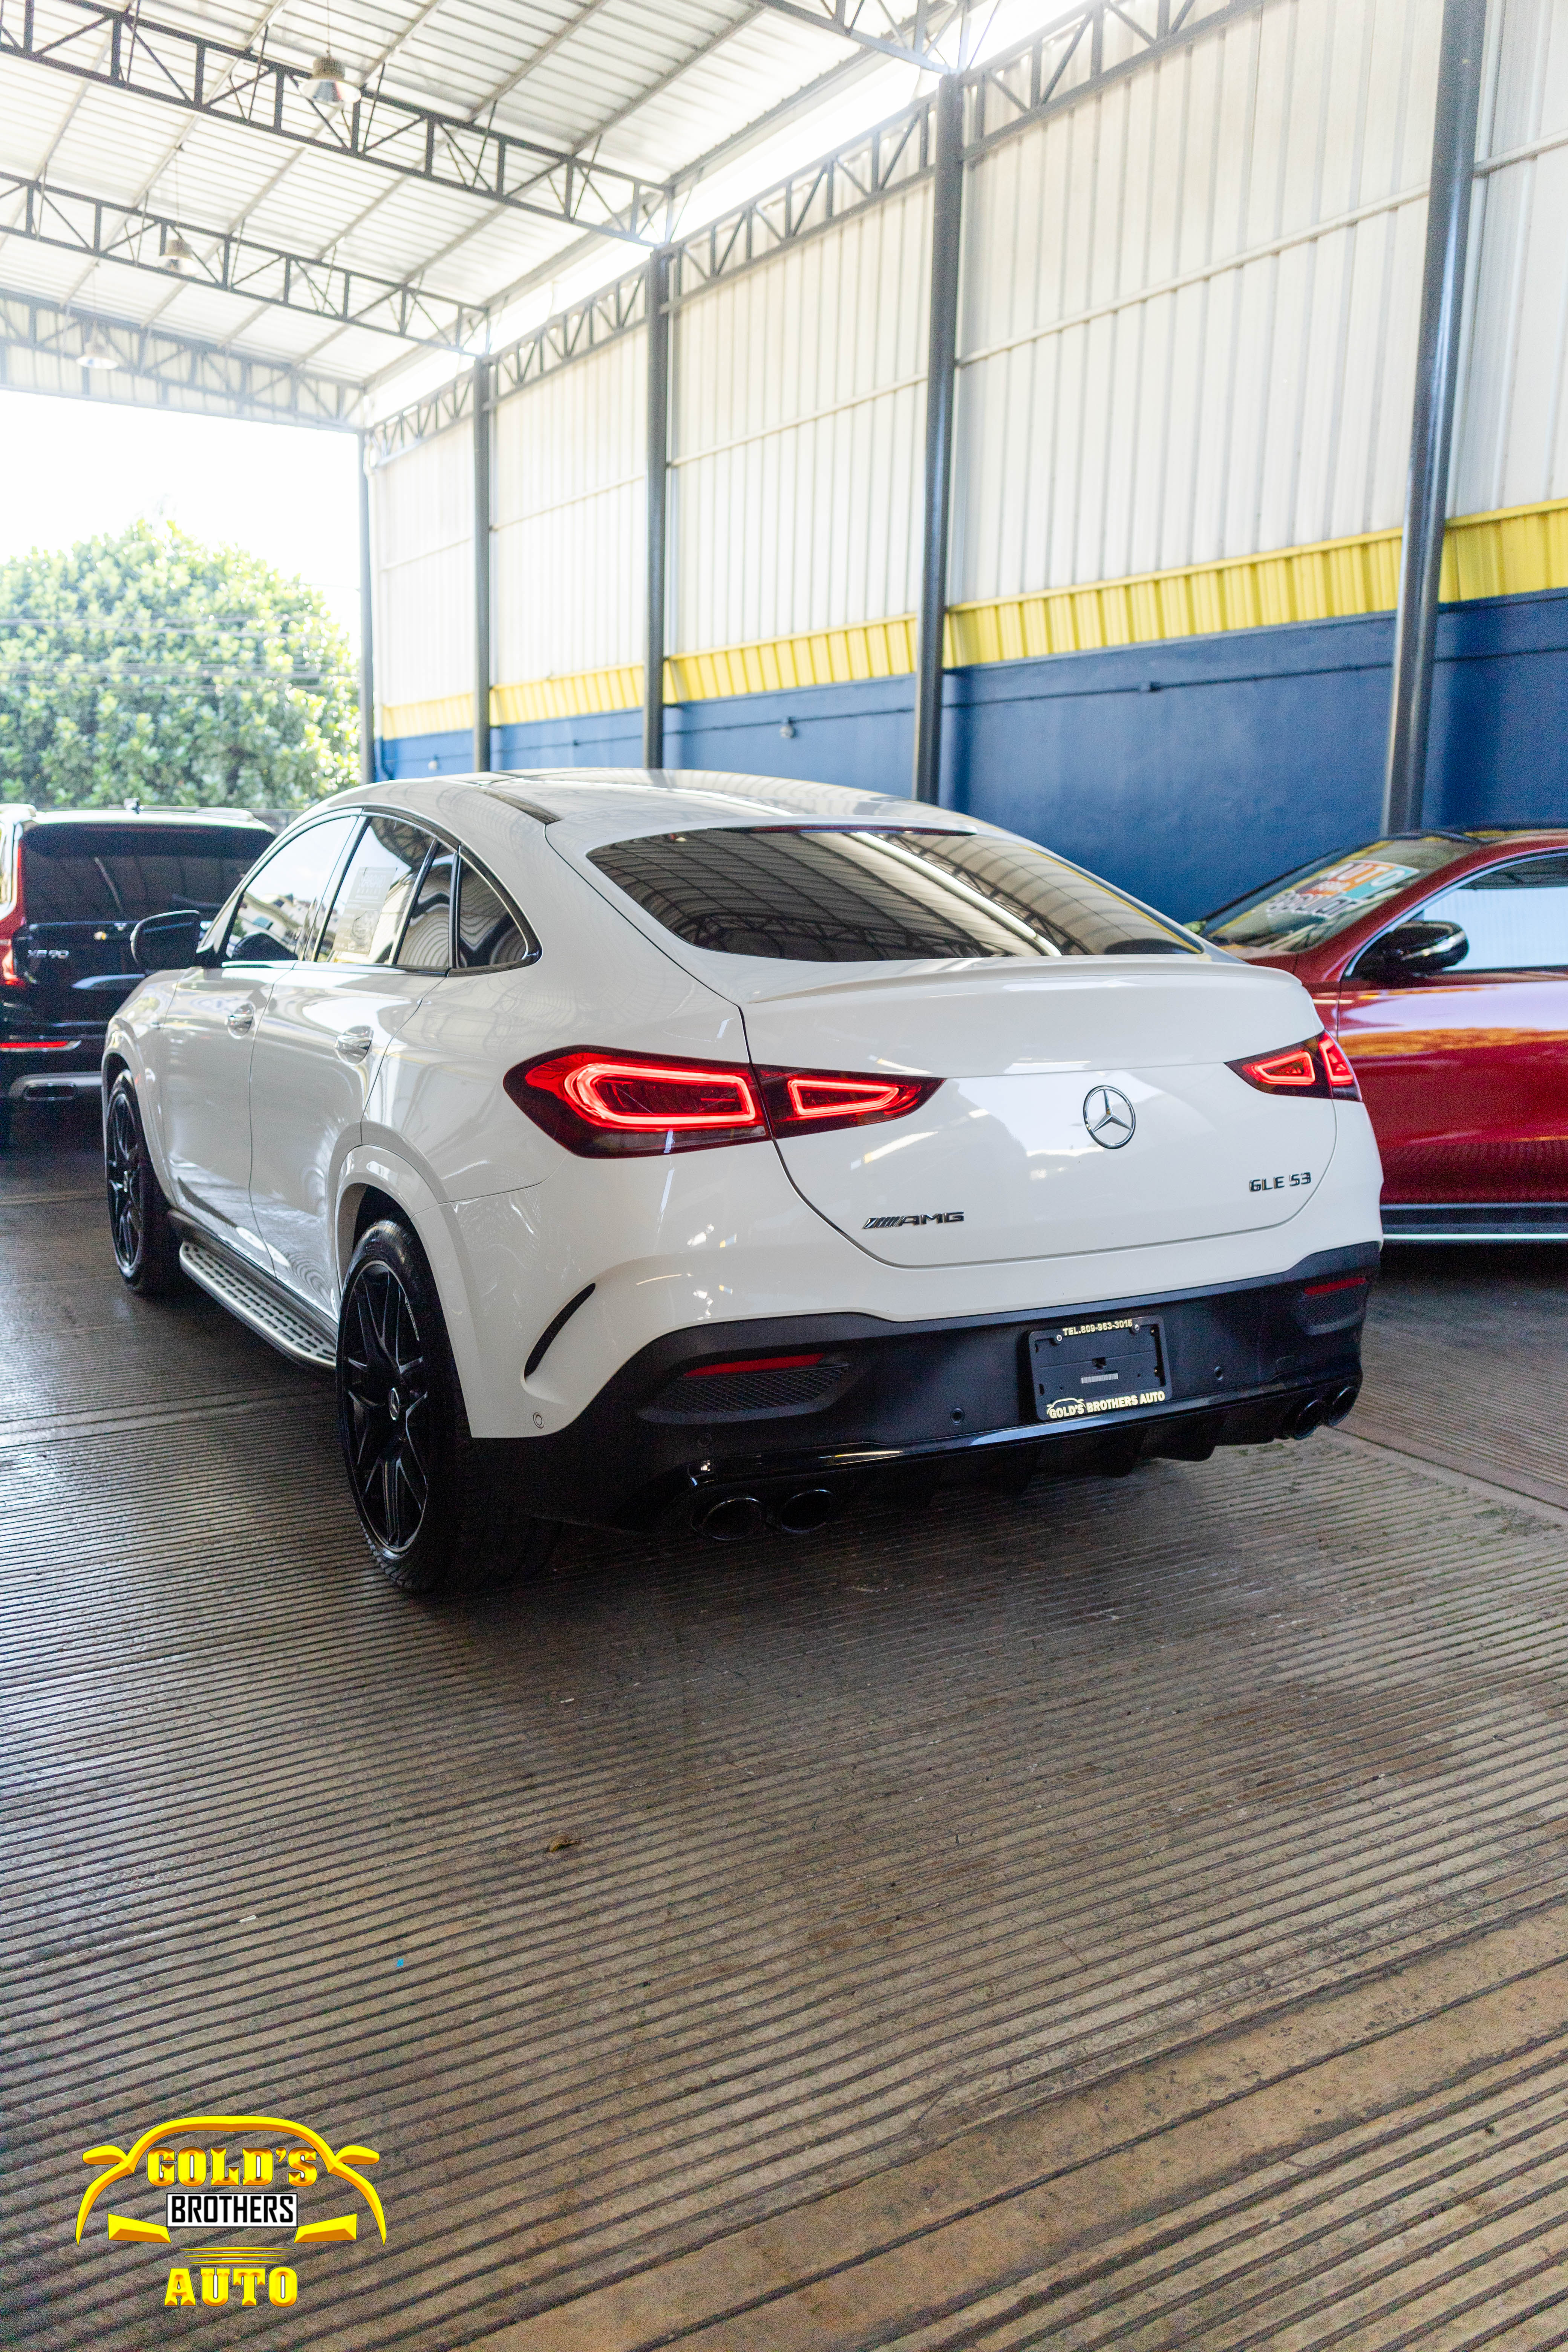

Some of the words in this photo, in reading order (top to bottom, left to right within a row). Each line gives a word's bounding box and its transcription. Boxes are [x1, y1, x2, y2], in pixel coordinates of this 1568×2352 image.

[1249, 1176, 1285, 1192] GLE
[1289, 1171, 1312, 1187] 53
[899, 1211, 965, 1227] AMG
[1063, 1319, 1133, 1336] TEL.809-963-3015
[1049, 1404, 1084, 1419] GOLD'S
[1086, 1395, 1138, 1413] BROTHERS
[1139, 1390, 1165, 1404] AUTO
